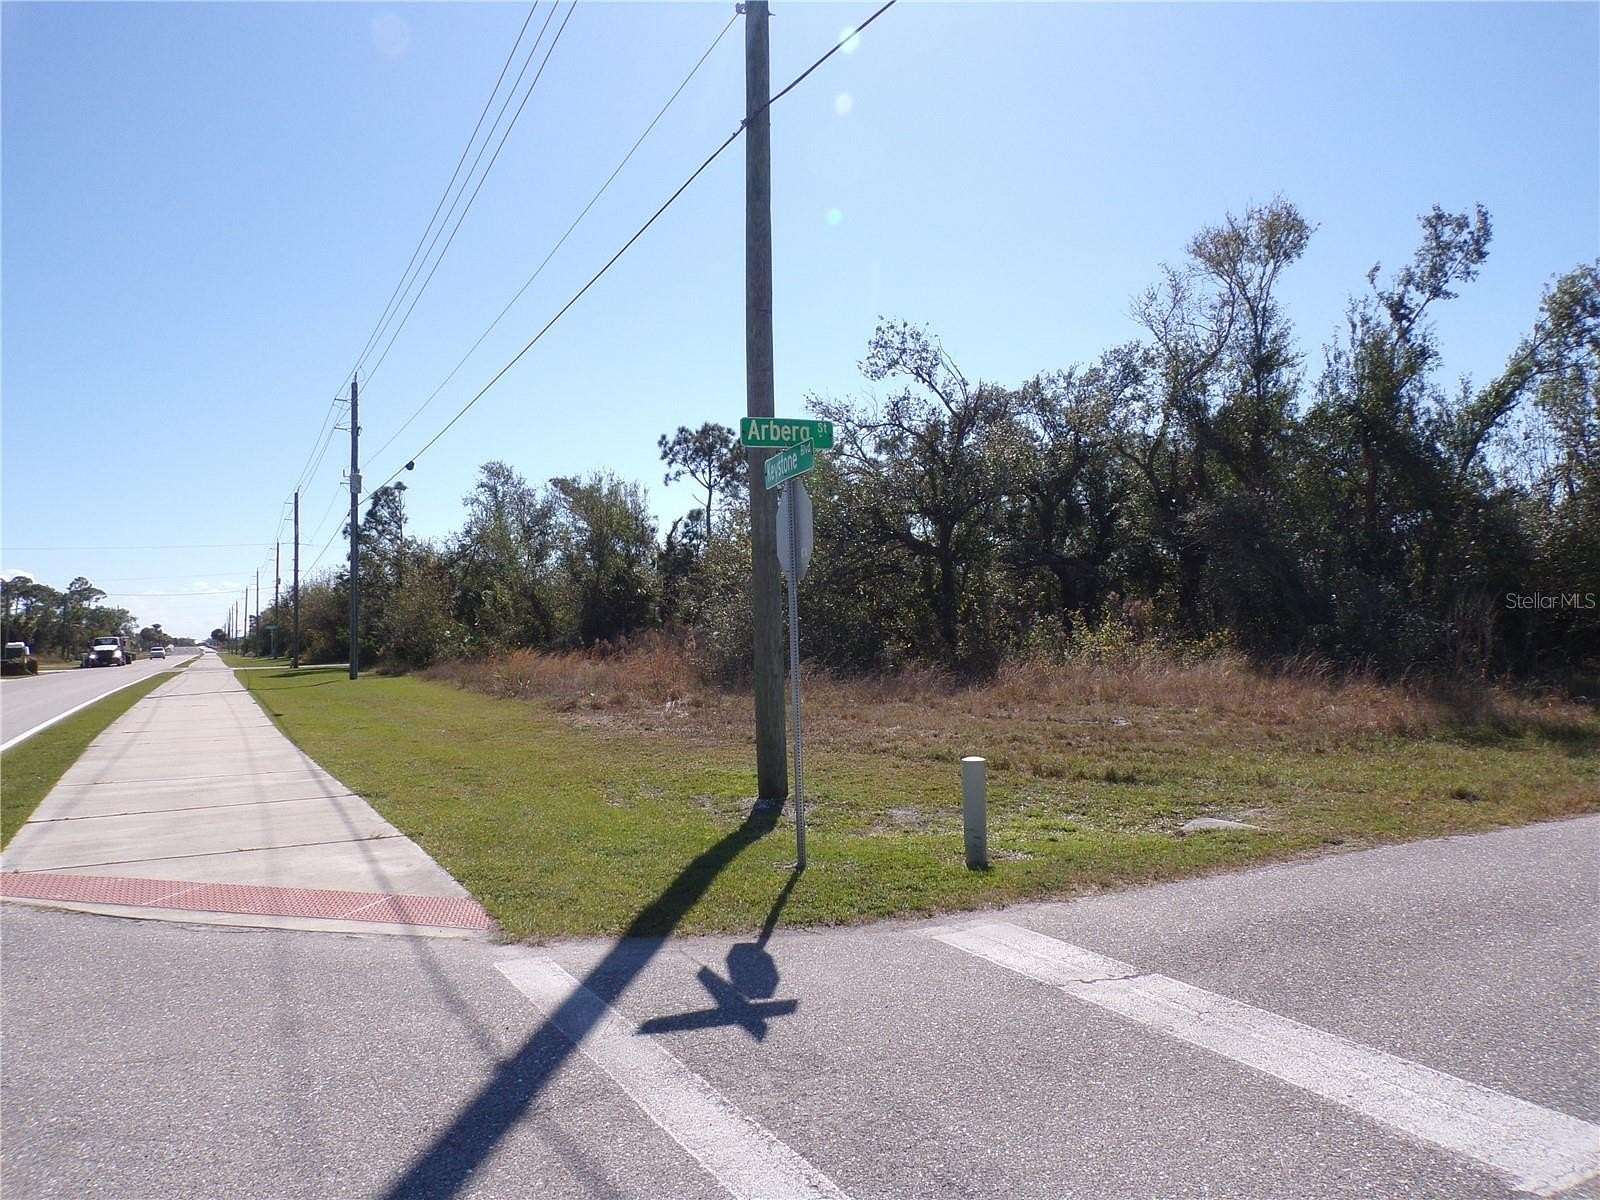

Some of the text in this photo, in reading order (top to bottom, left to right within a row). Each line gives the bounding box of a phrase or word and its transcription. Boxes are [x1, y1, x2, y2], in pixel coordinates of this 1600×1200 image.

[817, 422, 828, 434] St
[766, 442, 811, 481] Keystone Blvd
